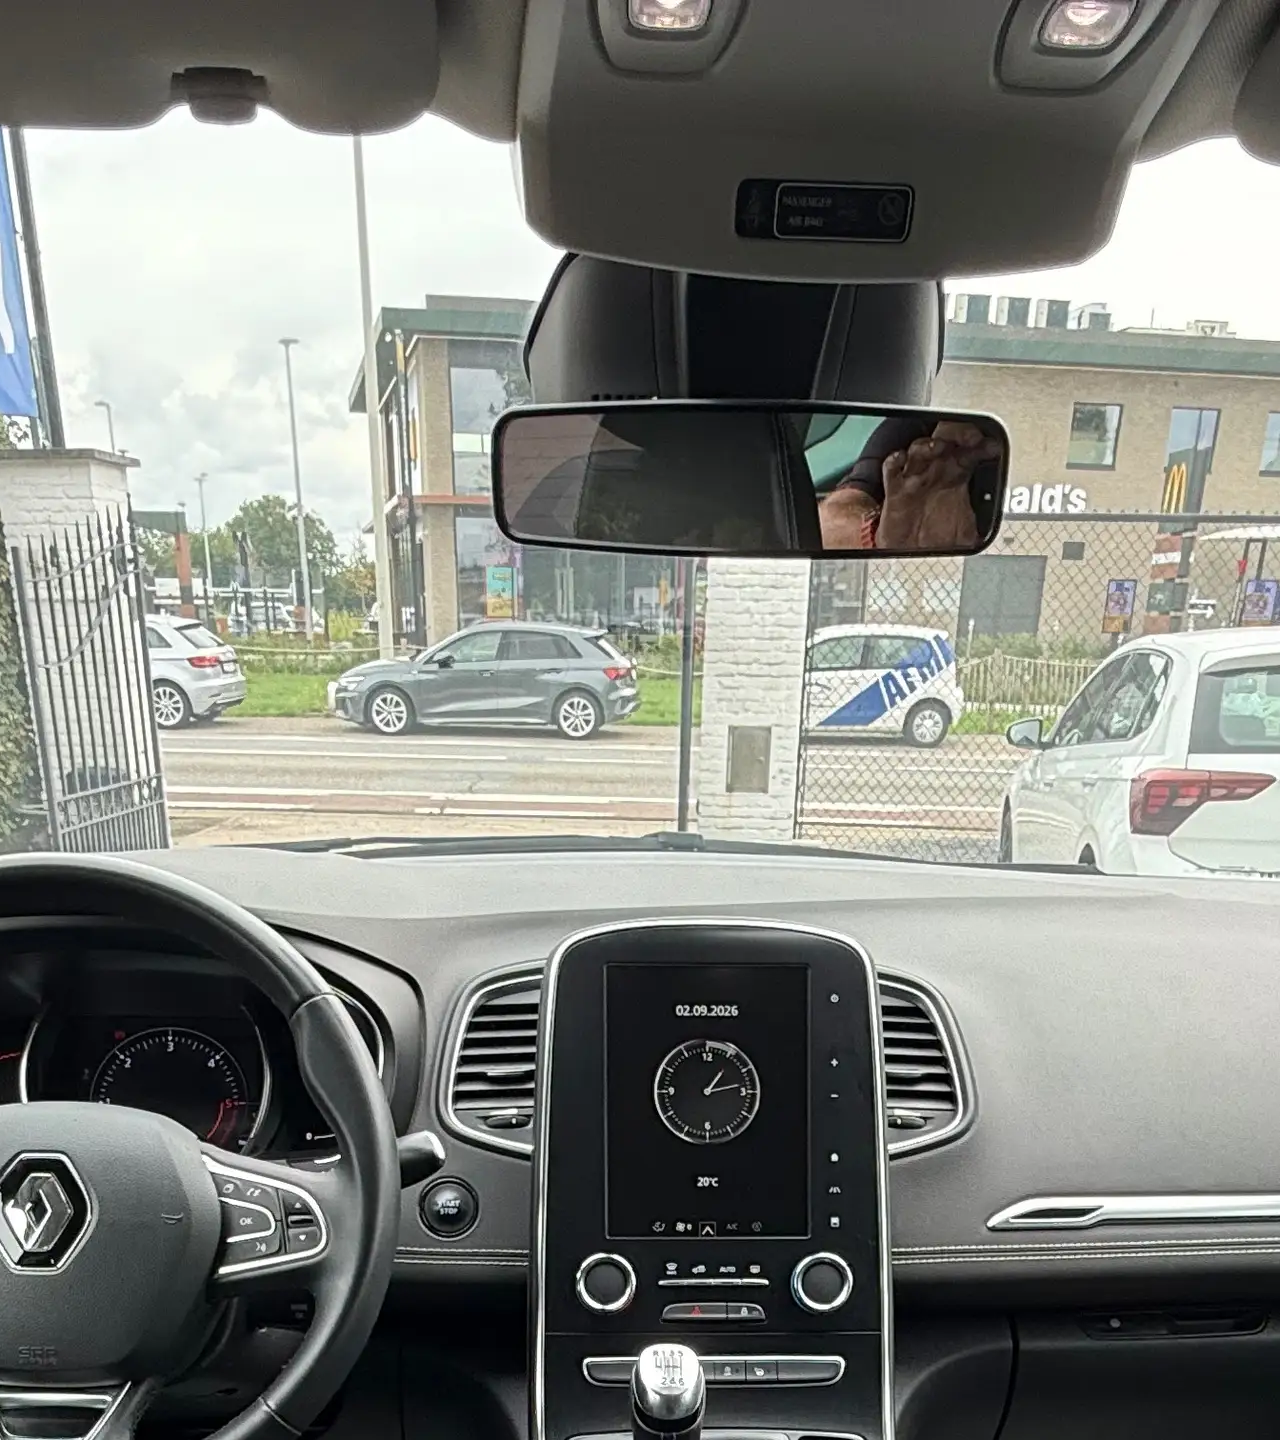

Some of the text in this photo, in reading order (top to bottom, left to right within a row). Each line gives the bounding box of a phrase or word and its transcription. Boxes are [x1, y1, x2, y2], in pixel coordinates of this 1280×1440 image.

[675, 1004, 739, 1017] 02.09.2026
[167, 1042, 174, 1051] 3
[702, 1052, 713, 1062] 12
[124, 1058, 131, 1068] 2
[208, 1058, 215, 1068] 4
[740, 1087, 747, 1096] 3
[704, 1121, 711, 1130] 6
[239, 1217, 253, 1226] OK
